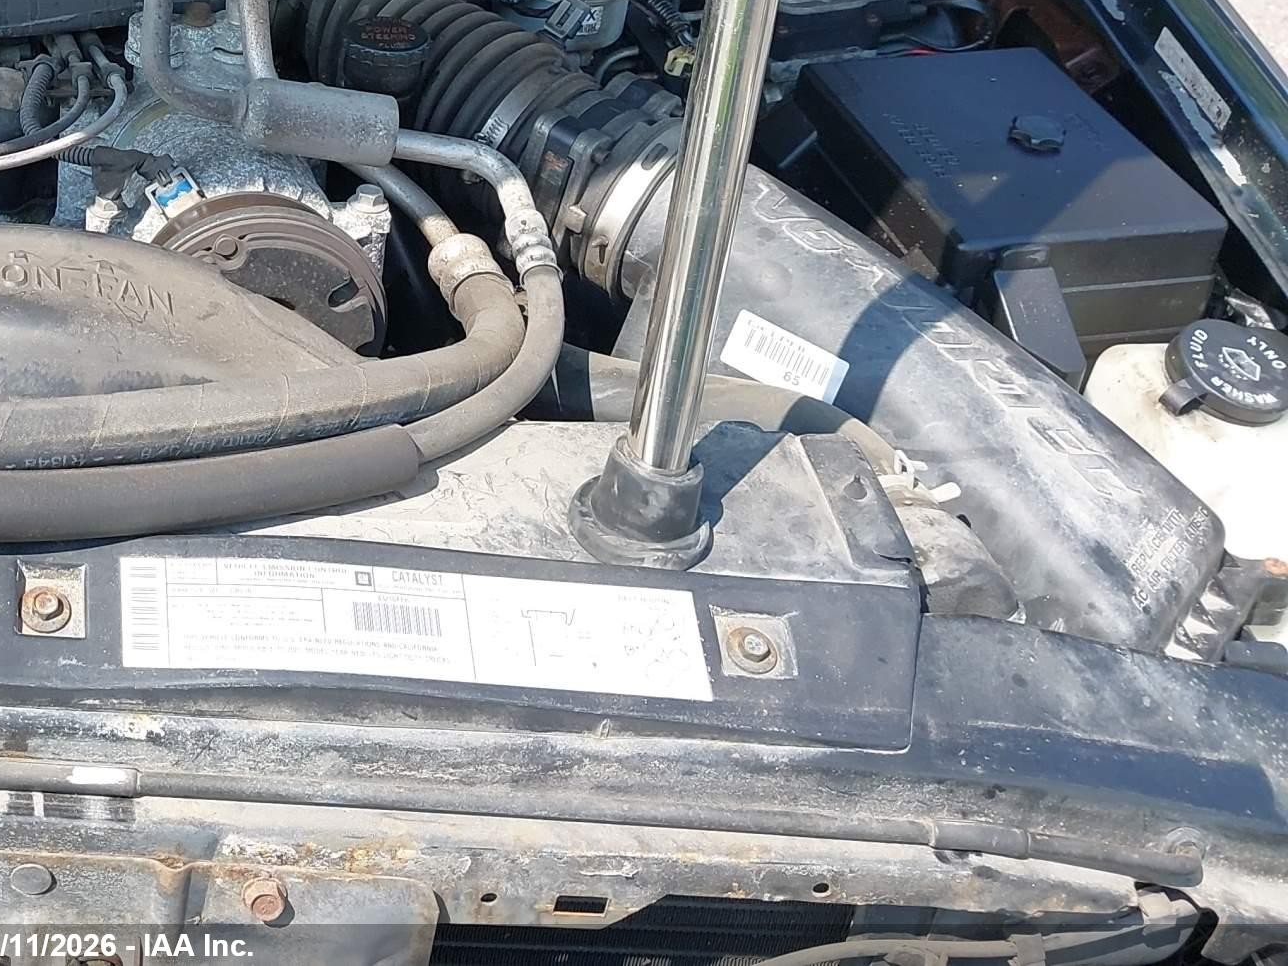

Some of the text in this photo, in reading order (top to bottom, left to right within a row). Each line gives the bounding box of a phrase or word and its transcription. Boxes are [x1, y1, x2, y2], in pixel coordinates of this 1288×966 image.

[96, 268, 174, 317] FAN
[782, 371, 801, 387] 65
[1189, 329, 1287, 404] WASHER FLUID ONLY
[391, 570, 443, 586] CATALYST
